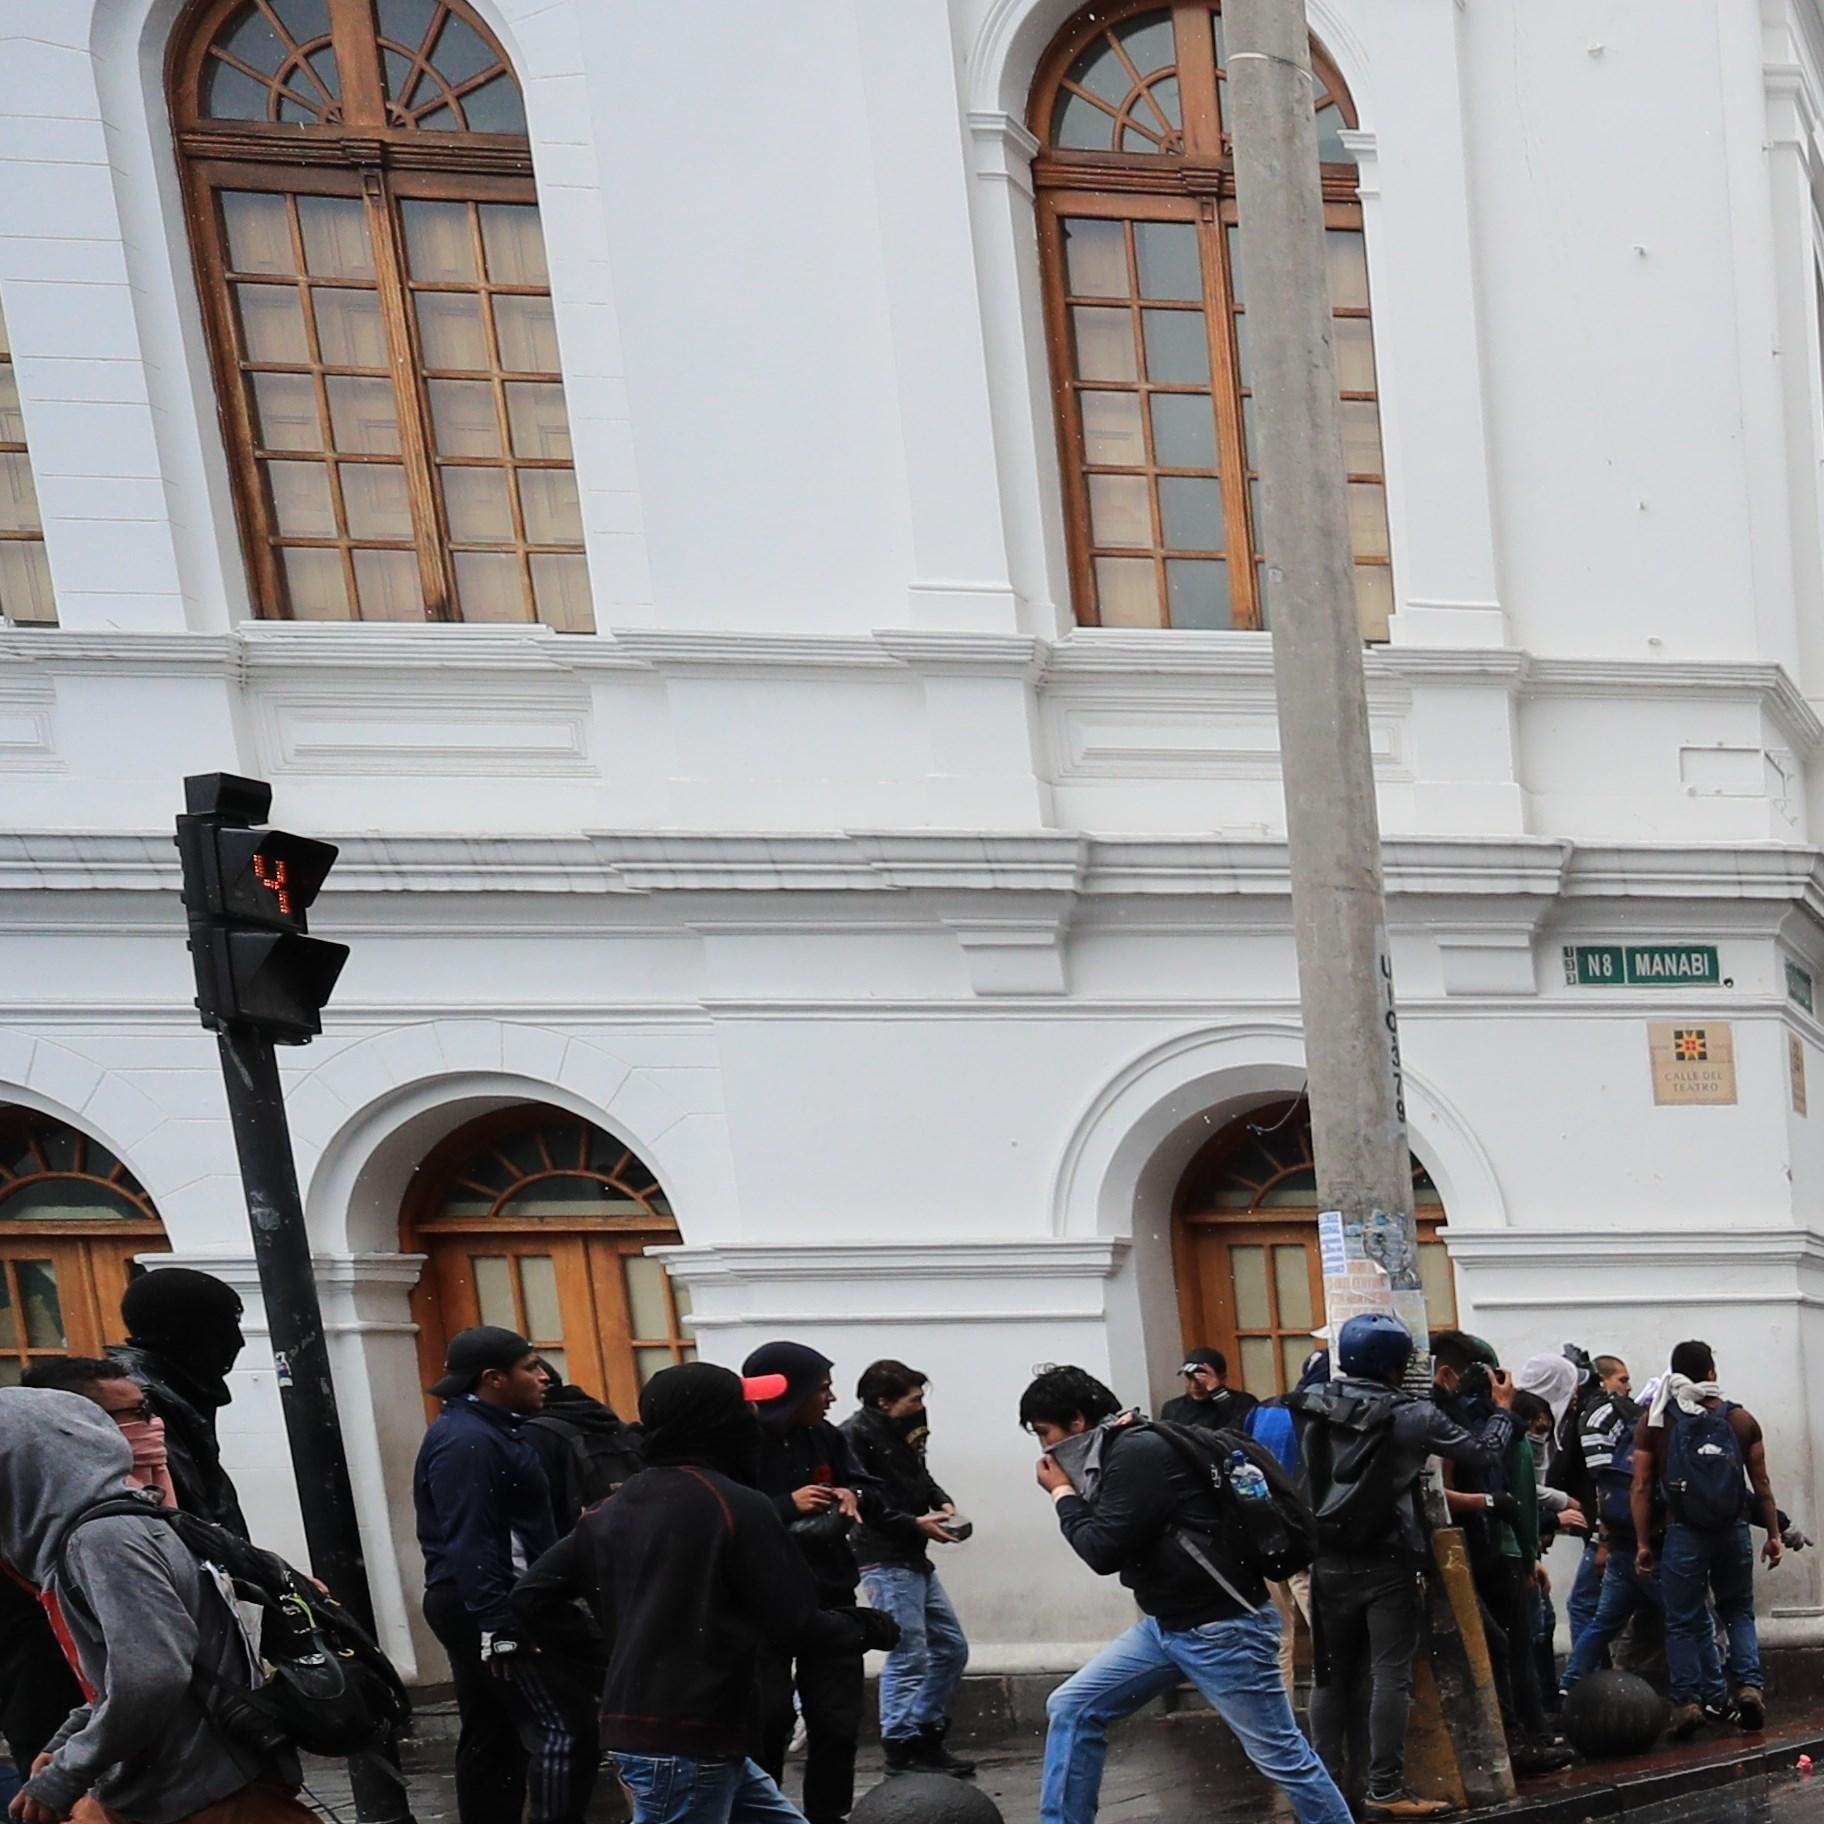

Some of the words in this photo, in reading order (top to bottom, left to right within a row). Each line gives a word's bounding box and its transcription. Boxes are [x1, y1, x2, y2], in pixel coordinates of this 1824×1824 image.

[1587, 953, 1613, 977] N8
[1634, 953, 1709, 977] MANABI
[1664, 1071, 1701, 1081] CALLE
[1702, 1071, 1723, 1081] DEL
[1672, 1081, 1719, 1092] TEATRO
